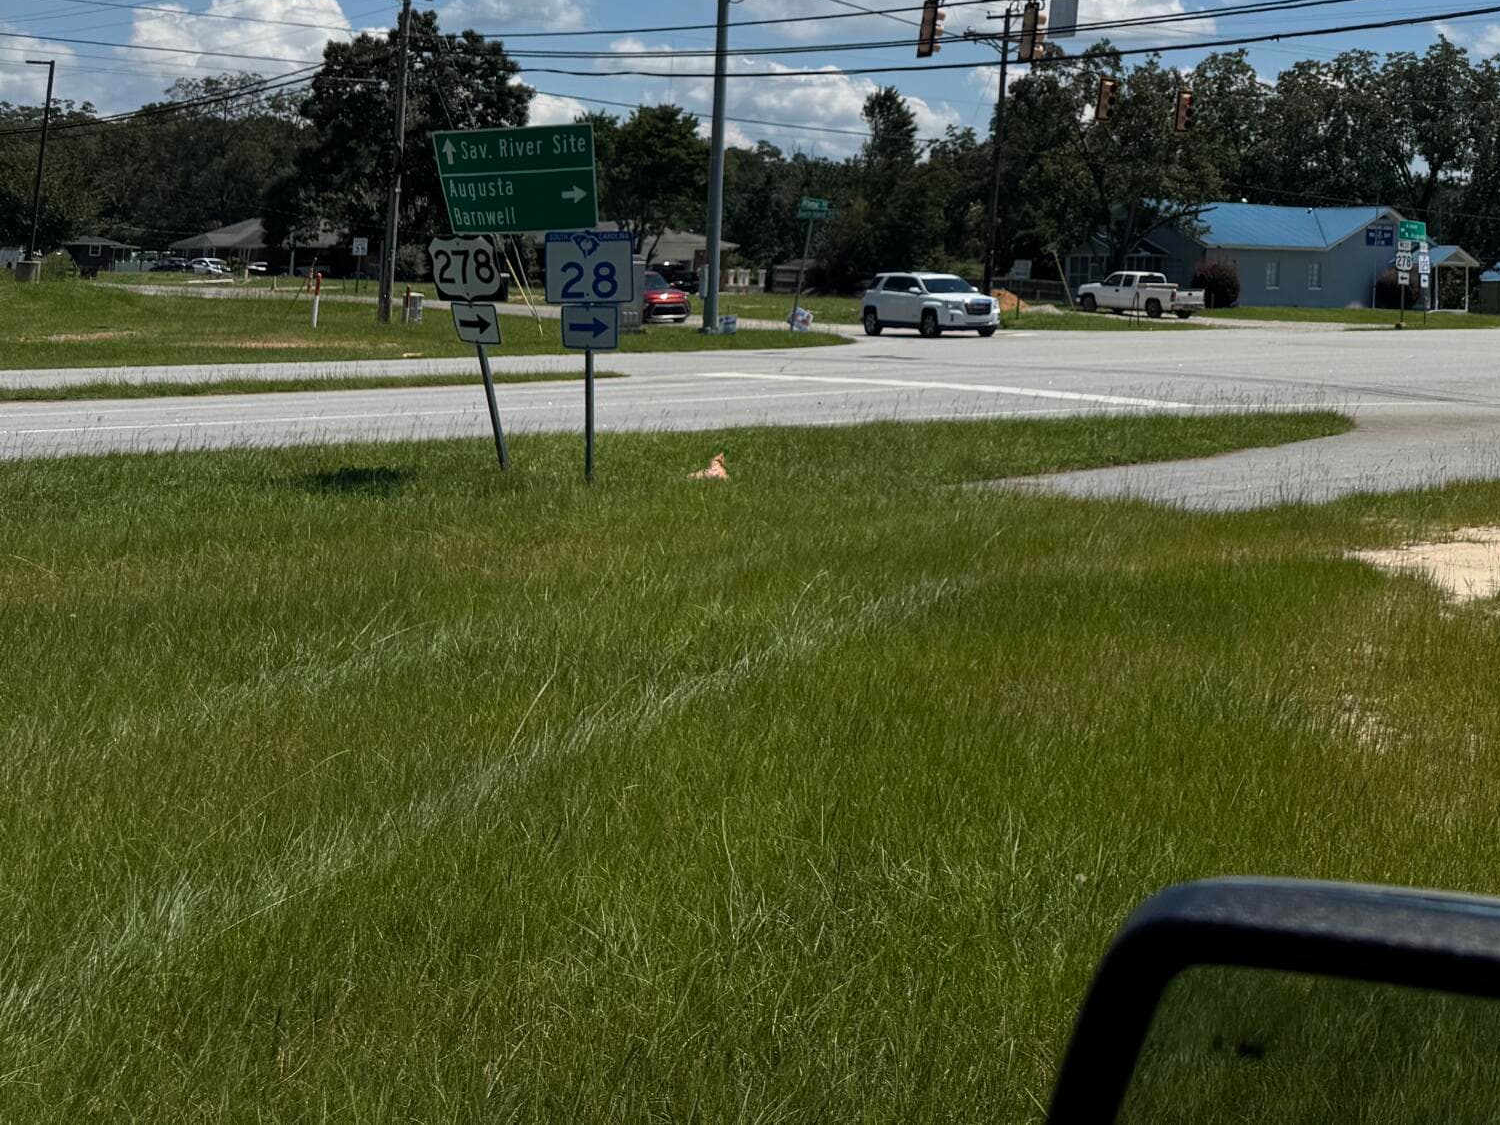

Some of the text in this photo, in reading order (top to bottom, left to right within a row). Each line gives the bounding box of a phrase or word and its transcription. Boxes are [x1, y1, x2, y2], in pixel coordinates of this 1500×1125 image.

[460, 134, 586, 160] Sav. River Site
[449, 177, 514, 202] Augusta
[453, 206, 516, 227] Barnwell
[433, 248, 495, 285] 278
[1397, 255, 1411, 267] 278
[560, 261, 618, 299] 28
